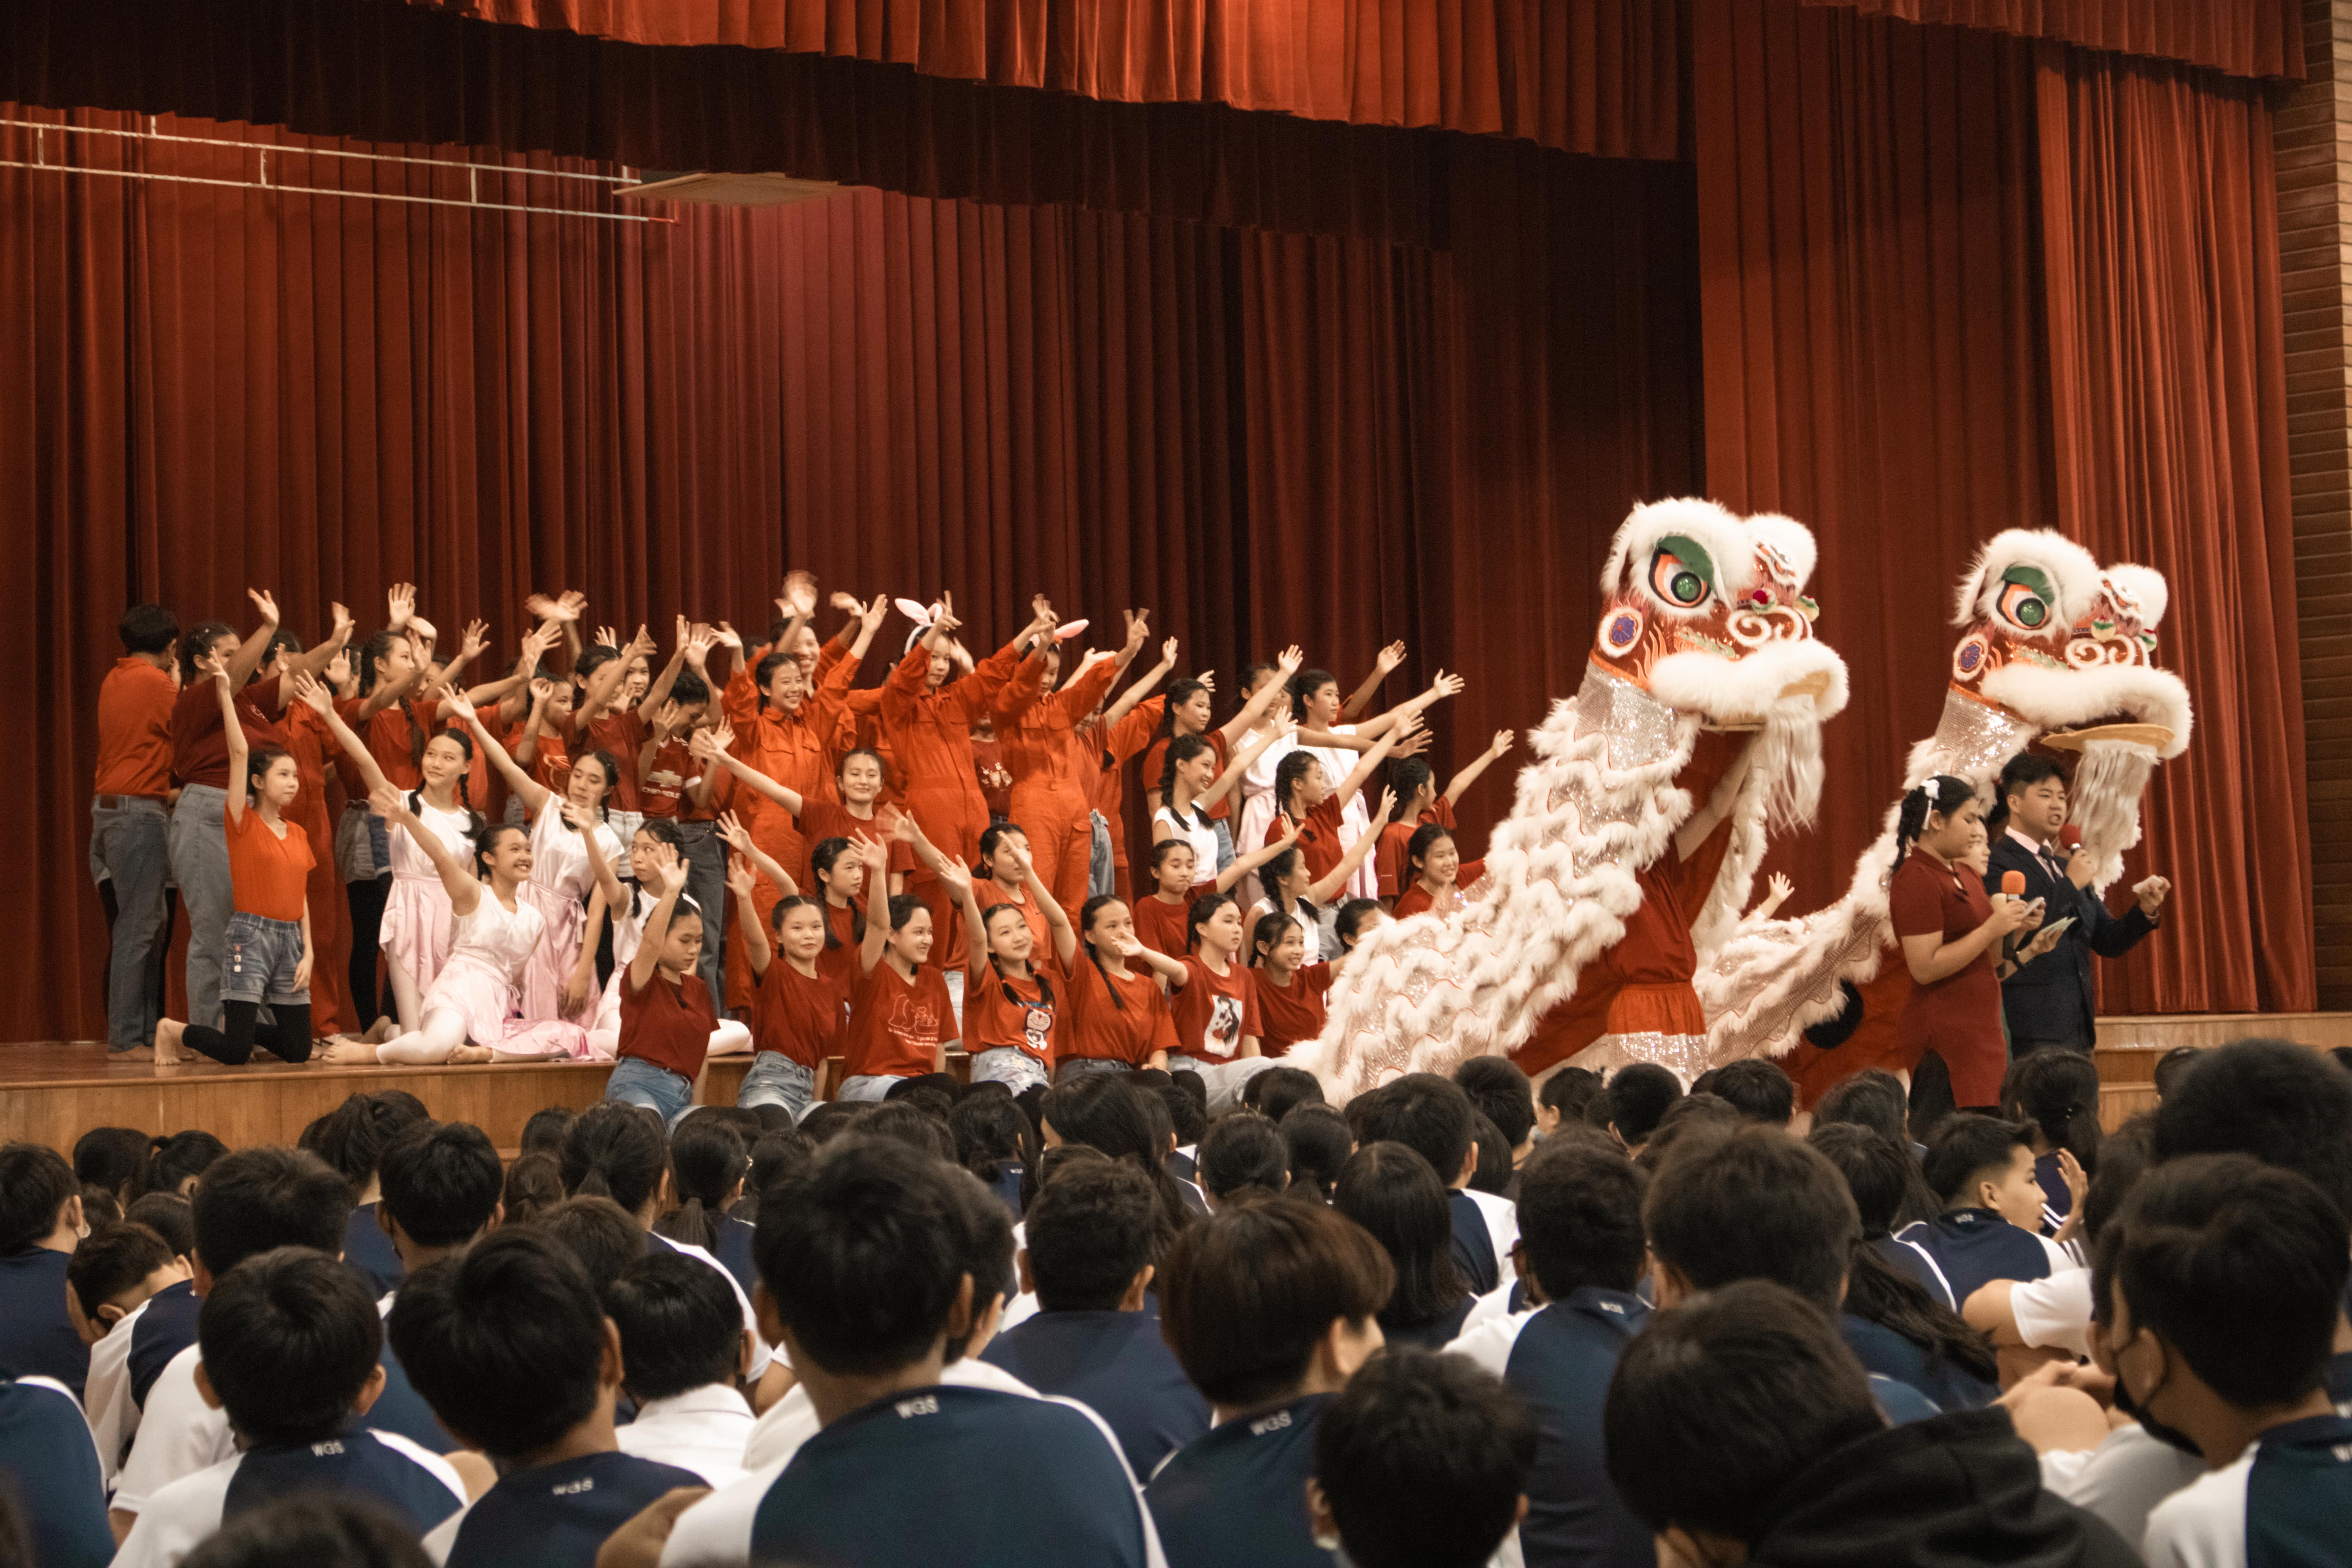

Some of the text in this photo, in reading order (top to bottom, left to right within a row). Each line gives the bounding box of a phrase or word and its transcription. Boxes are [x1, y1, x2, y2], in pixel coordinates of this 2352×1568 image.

[895, 1395, 938, 1418] WGS
[1251, 1411, 1292, 1435] WGS
[312, 1441, 345, 1456] WGS
[552, 1479, 593, 1495] WGS
